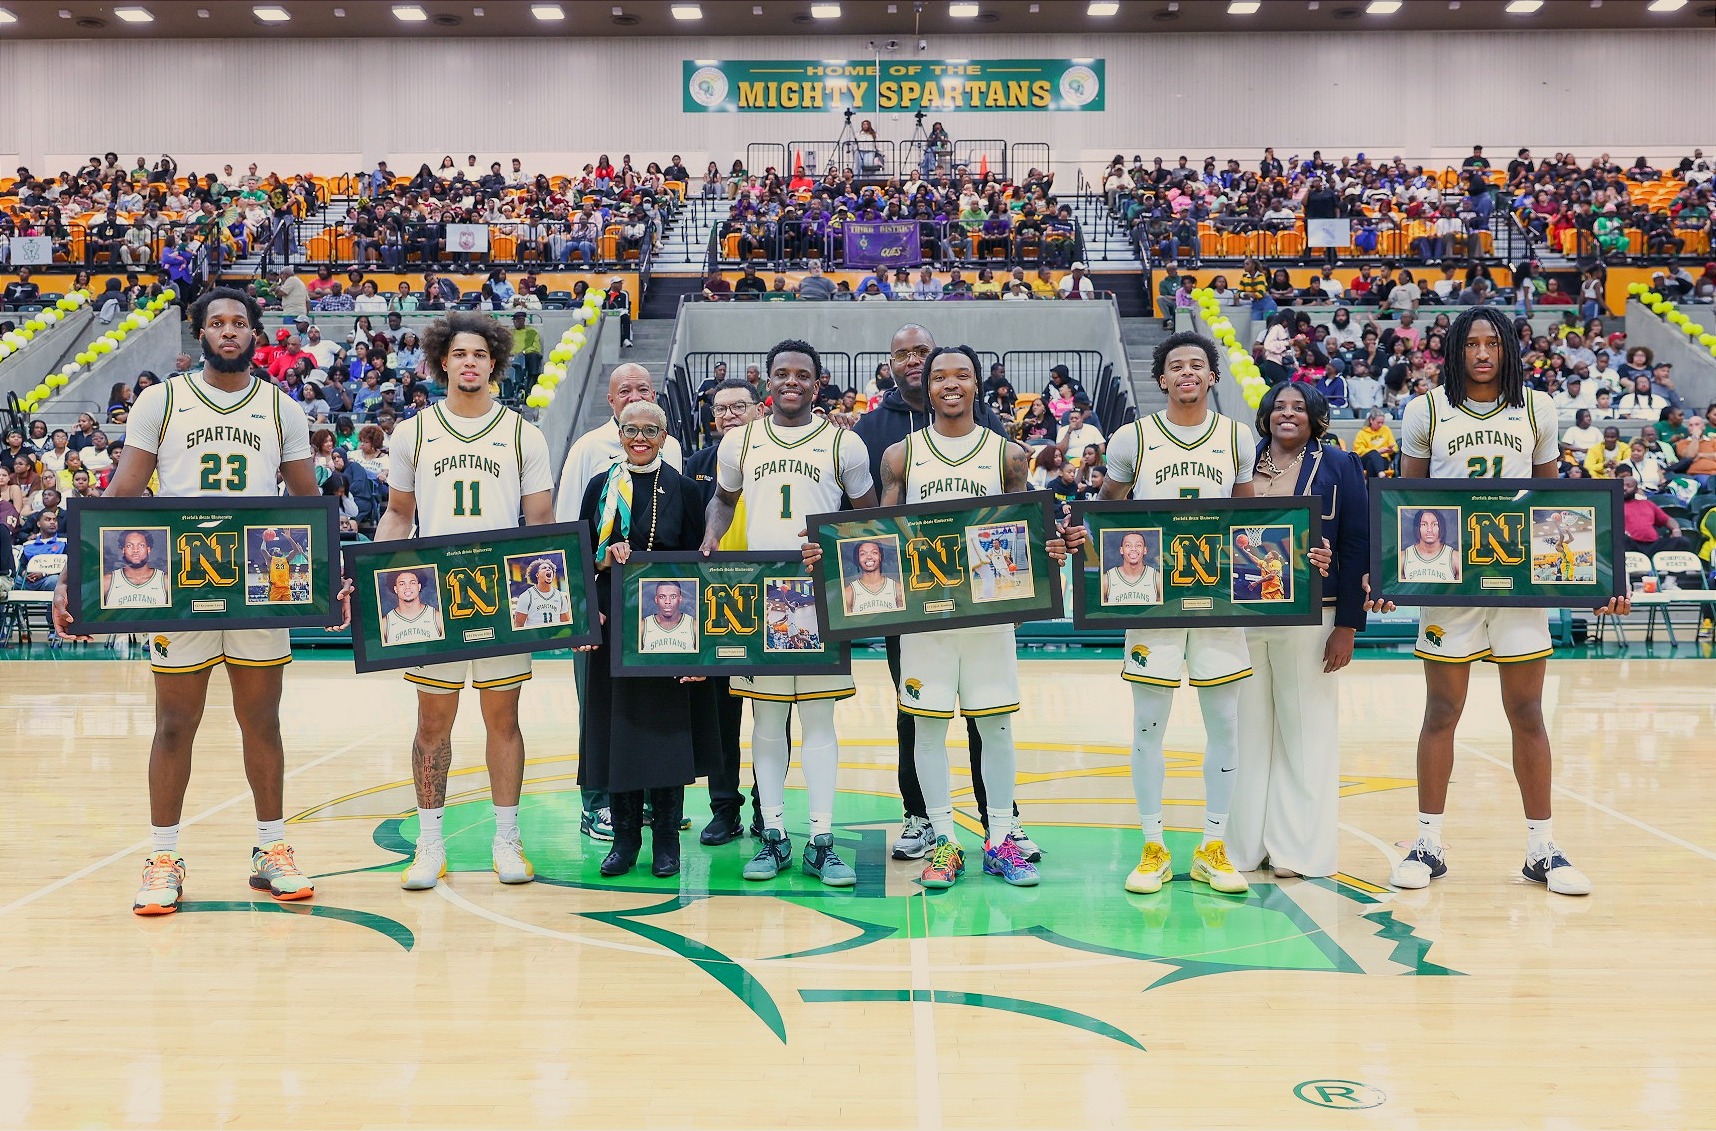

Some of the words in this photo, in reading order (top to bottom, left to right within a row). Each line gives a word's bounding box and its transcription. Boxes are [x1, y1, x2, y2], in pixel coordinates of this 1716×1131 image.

[806, 66, 880, 76] HOME
[889, 66, 922, 76] OF
[930, 65, 981, 75] THE
[737, 81, 868, 109] MIGHTY
[879, 80, 1052, 109] SPARTANS
[186, 425, 260, 452] SPARTANS
[1448, 430, 1522, 456] SPARTANS
[200, 452, 248, 492] 23
[434, 454, 501, 478] SPARTANS
[754, 459, 821, 483] SPARTANS
[1155, 462, 1223, 485] SPARTANS
[1467, 455, 1505, 478] 21
[452, 479, 482, 517] 11
[920, 477, 987, 499] SPARTANS
[780, 484, 792, 520] 1
[1409, 568, 1447, 580] SPARTANS
[118, 594, 157, 606] SPARTANS
[859, 599, 893, 612] SPARTANS
[1115, 591, 1150, 603] SPARTANS
[395, 627, 431, 642] SPARTANS
[650, 637, 687, 650] SPARTANS
